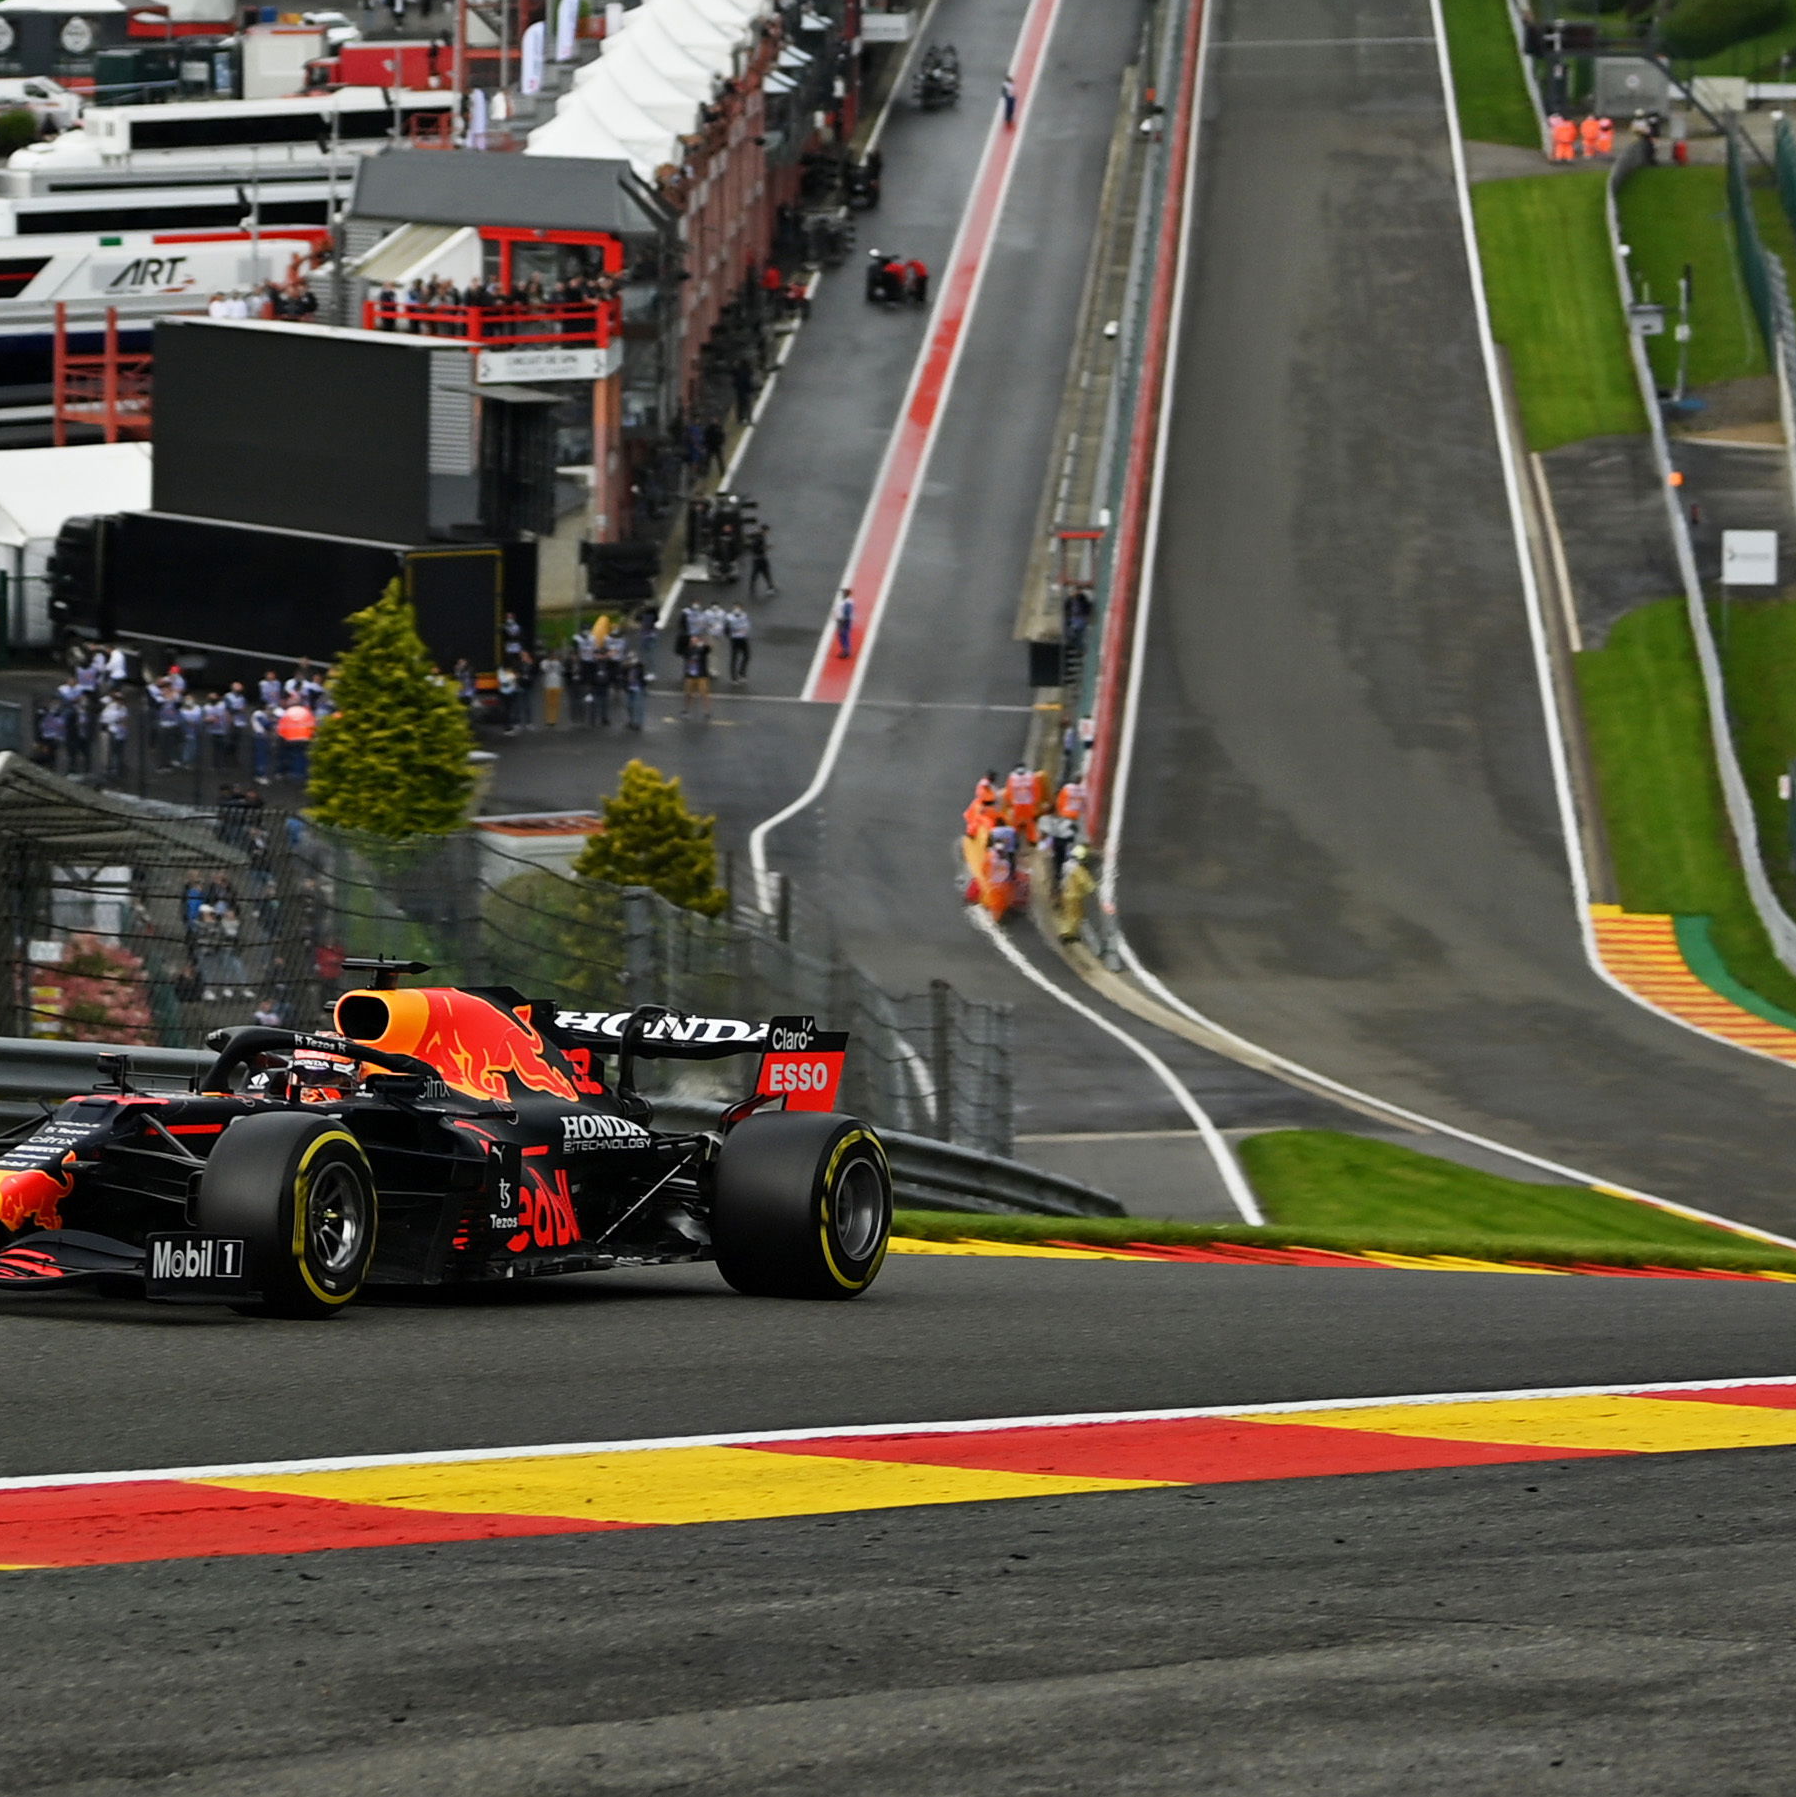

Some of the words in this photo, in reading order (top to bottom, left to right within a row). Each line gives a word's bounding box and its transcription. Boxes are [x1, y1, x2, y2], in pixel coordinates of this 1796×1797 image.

[109, 255, 187, 287] ART
[305, 1036, 335, 1051] Tezos
[769, 1062, 828, 1092] ESSO
[560, 1115, 649, 1139] HONDA
[490, 1214, 518, 1229] Tezos
[152, 1239, 212, 1279] Mobil
